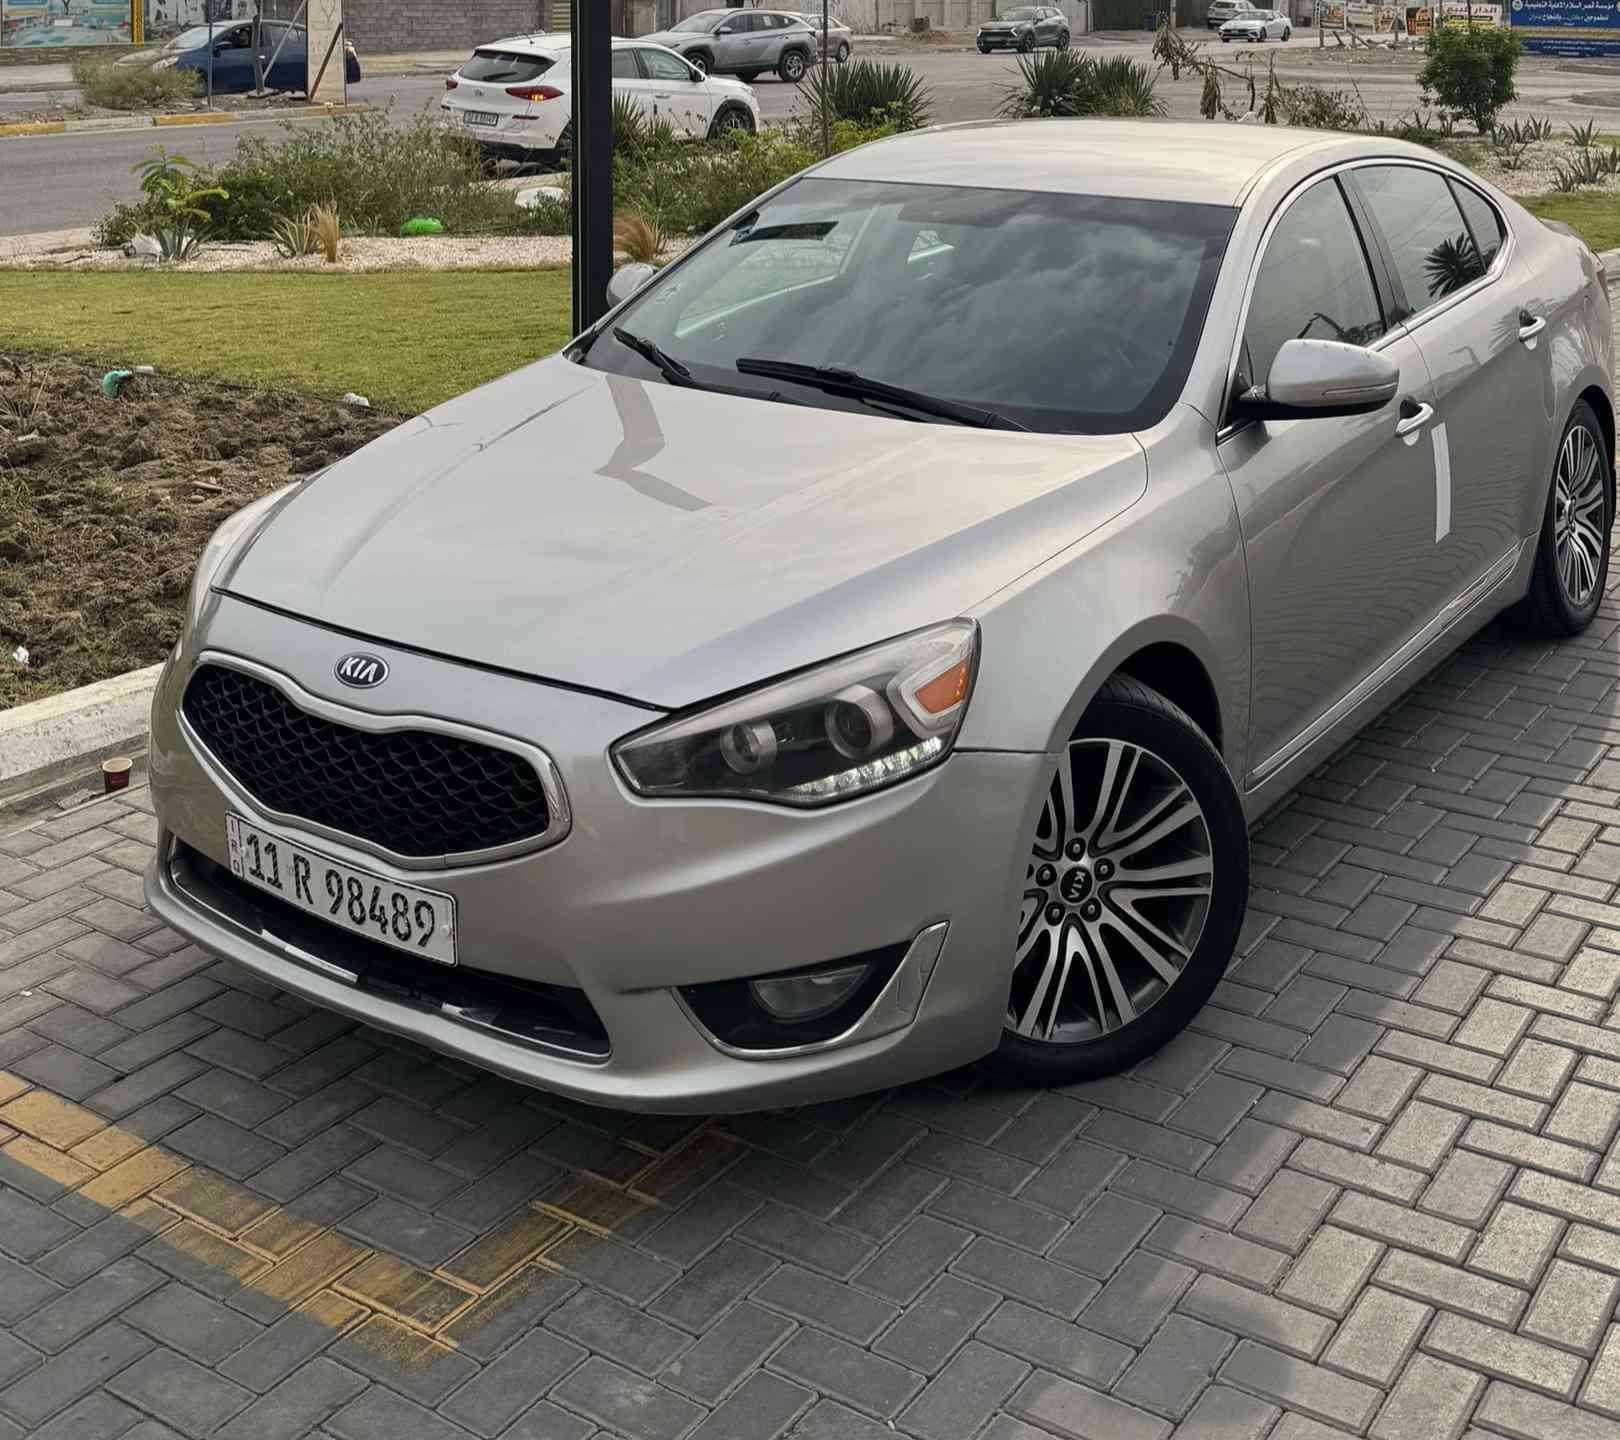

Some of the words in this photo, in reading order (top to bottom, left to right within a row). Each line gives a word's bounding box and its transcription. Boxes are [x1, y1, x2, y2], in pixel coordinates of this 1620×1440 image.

[340, 657, 378, 682] KIA
[230, 820, 241, 873] IRQ
[246, 832, 283, 891] 11
[292, 852, 314, 905] R
[325, 869, 435, 948] 98489
[1068, 871, 1086, 899] KIA
